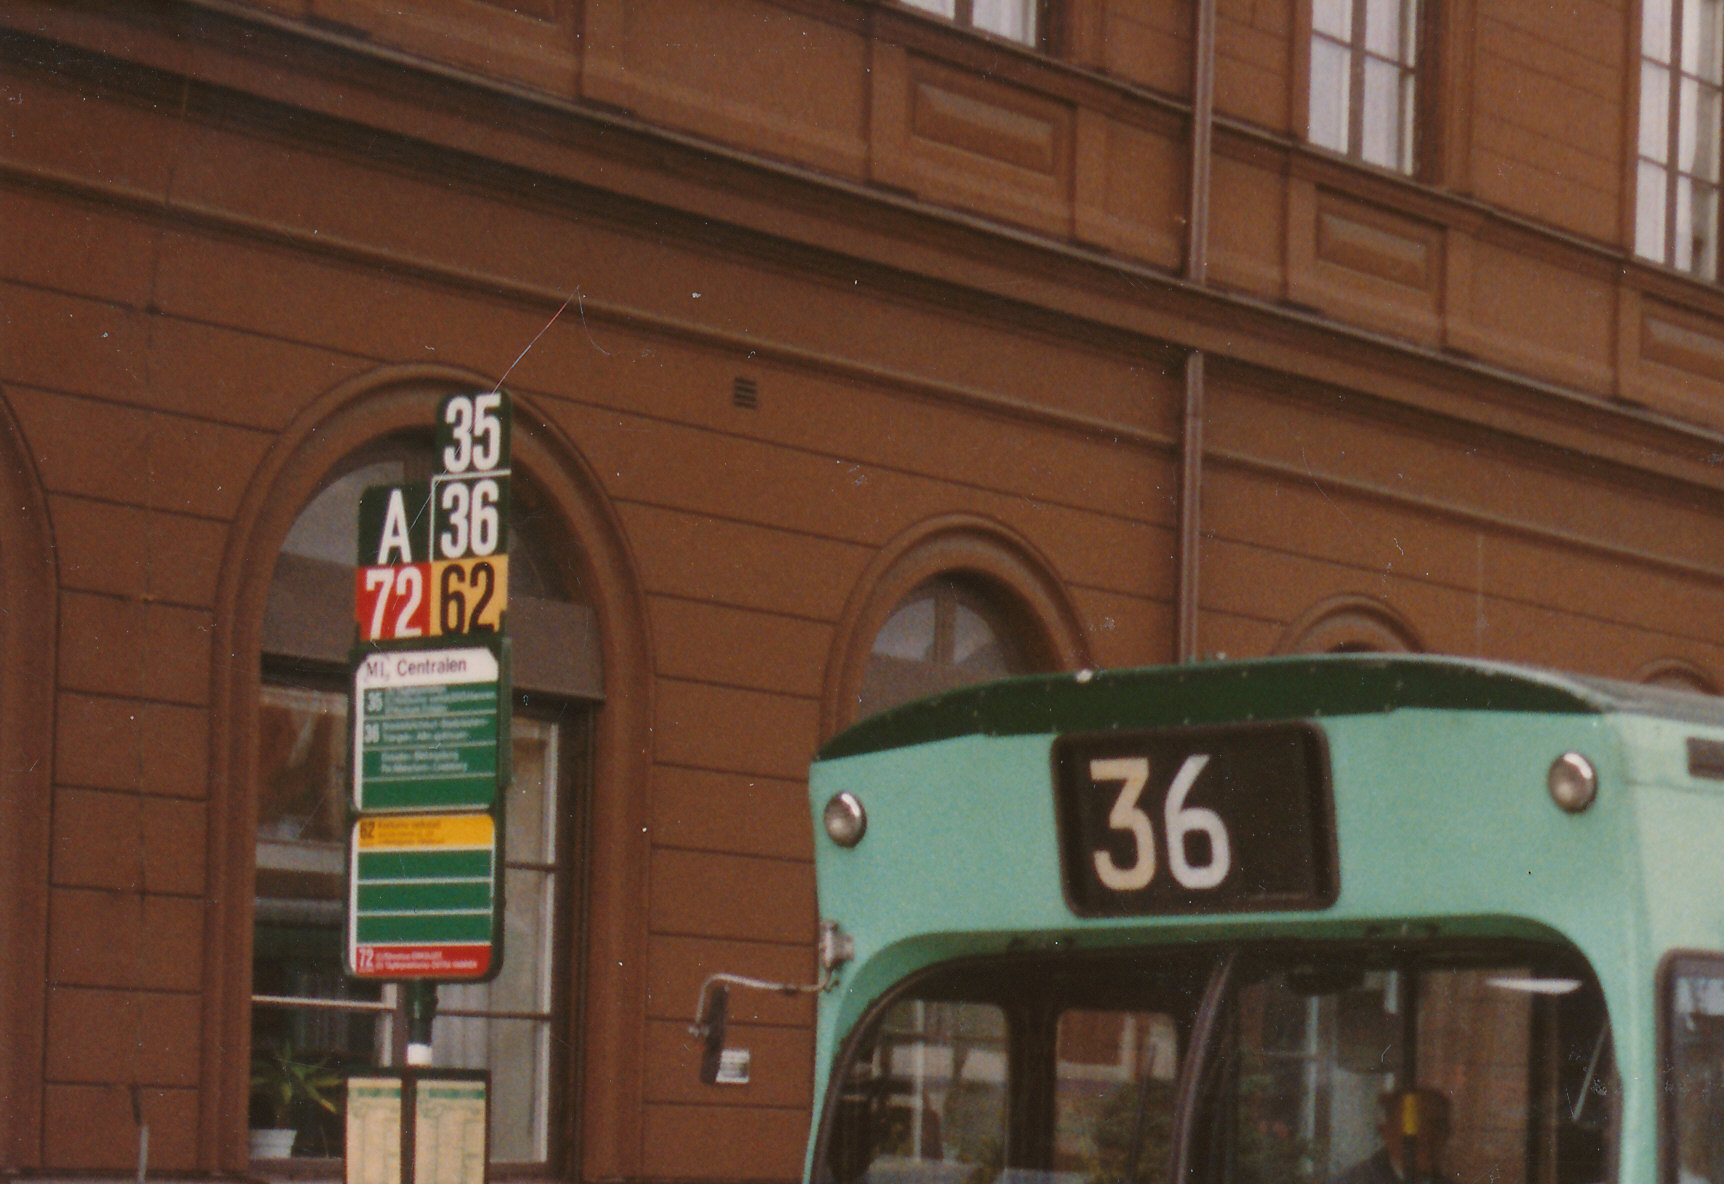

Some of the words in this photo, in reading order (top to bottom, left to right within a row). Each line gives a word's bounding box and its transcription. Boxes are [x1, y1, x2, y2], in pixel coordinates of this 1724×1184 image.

[443, 392, 502, 473] 35
[377, 488, 412, 565] A
[440, 478, 499, 559] 36
[365, 566, 423, 640] 72
[439, 562, 496, 635] 62
[397, 657, 467, 677] Centralen
[1088, 752, 1232, 892] 36
[358, 947, 374, 968] 72
